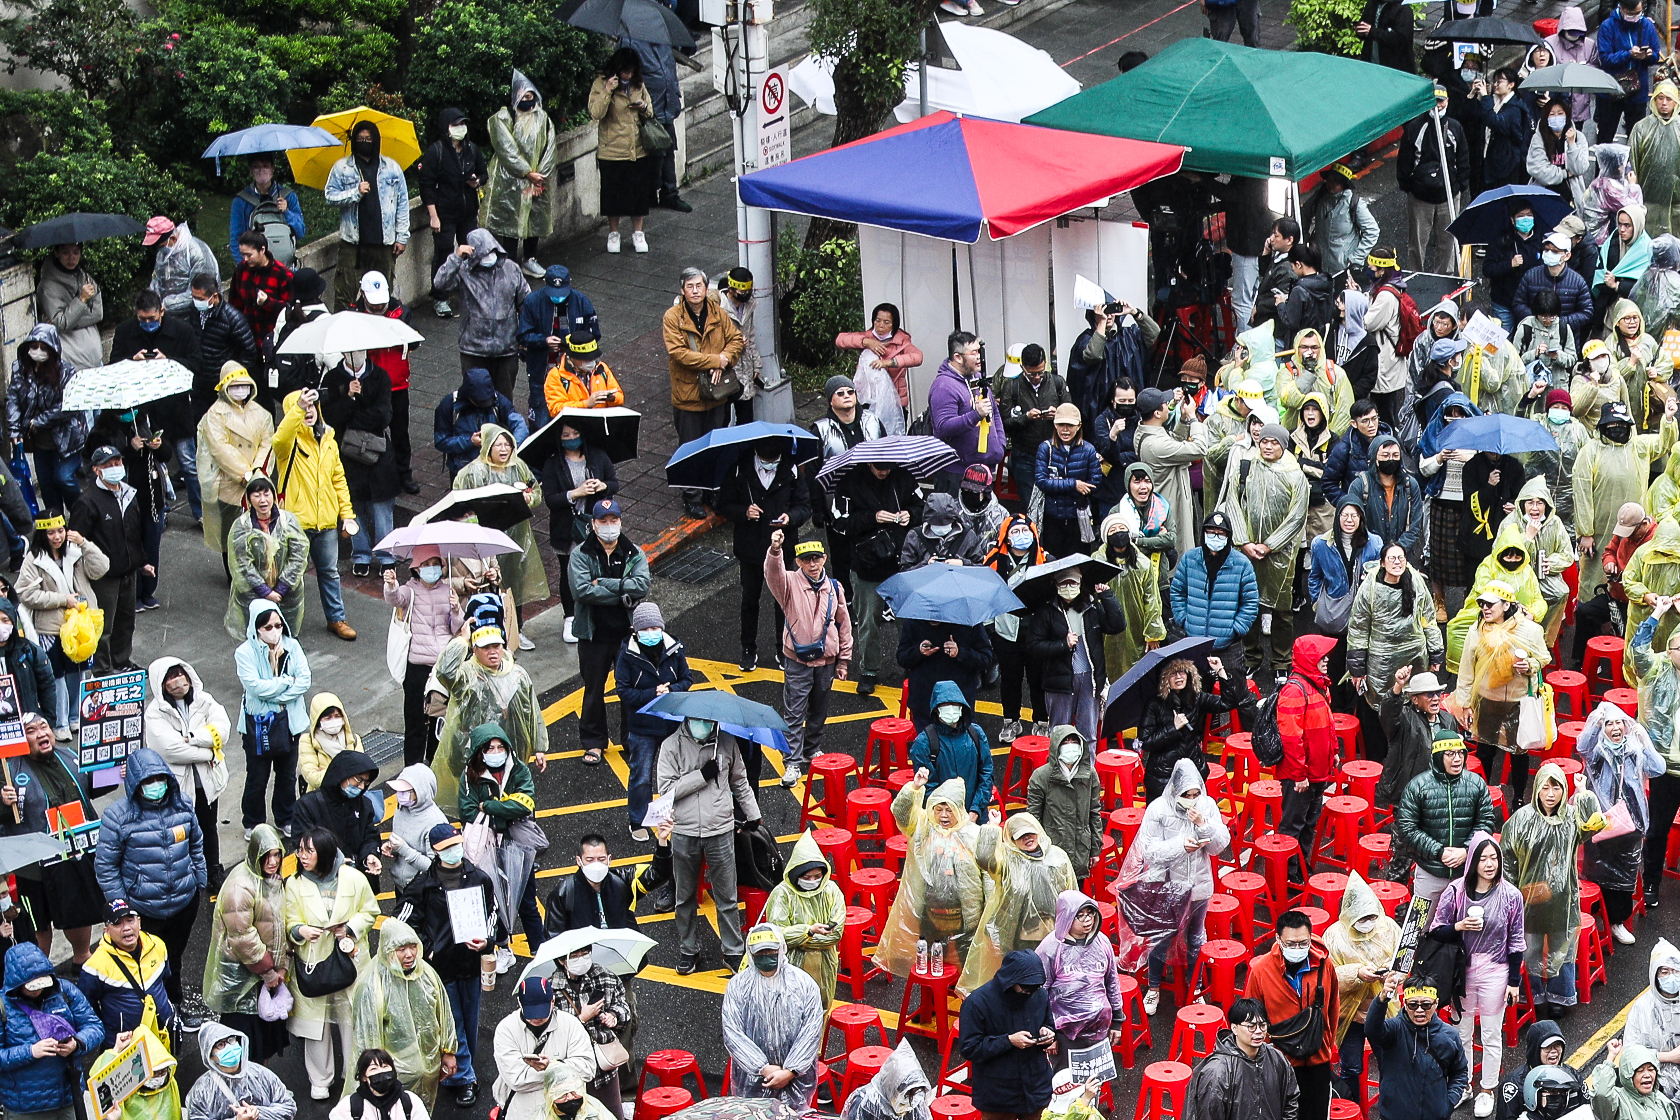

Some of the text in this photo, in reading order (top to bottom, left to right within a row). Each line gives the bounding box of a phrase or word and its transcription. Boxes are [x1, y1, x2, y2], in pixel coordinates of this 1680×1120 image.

[967, 468, 986, 483] TAIWAN
[101, 685, 142, 704] 葉元之
